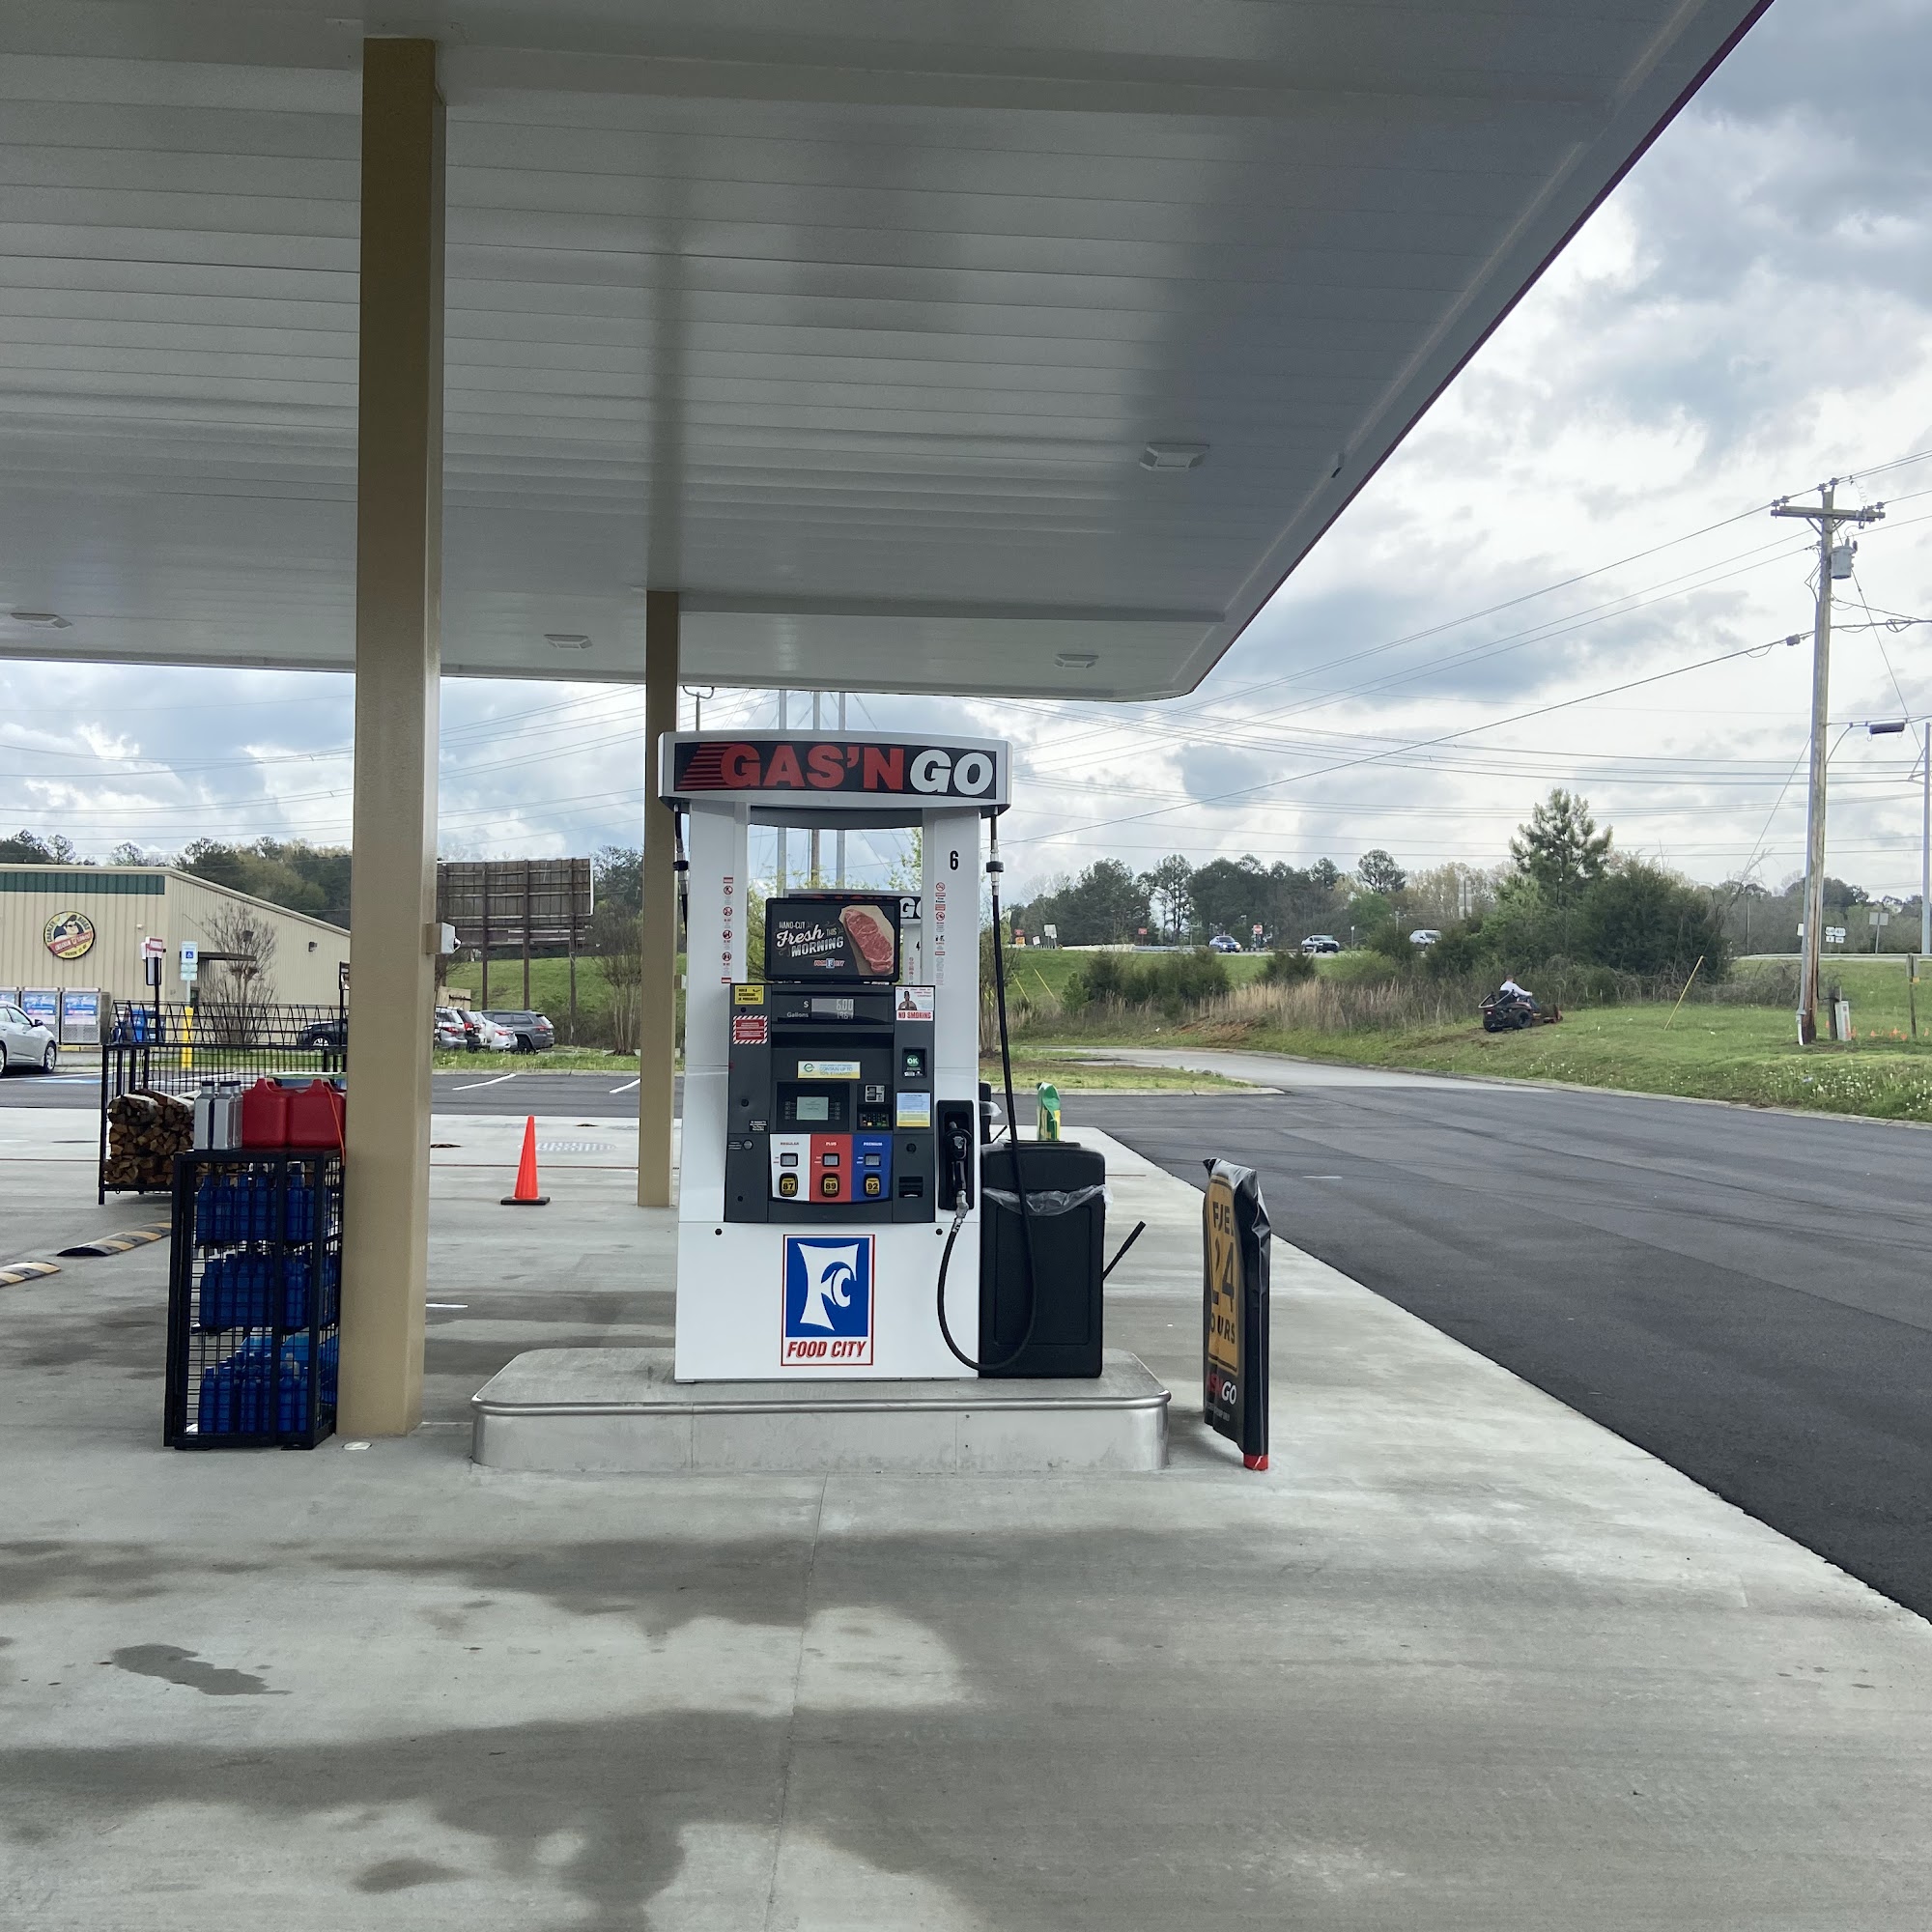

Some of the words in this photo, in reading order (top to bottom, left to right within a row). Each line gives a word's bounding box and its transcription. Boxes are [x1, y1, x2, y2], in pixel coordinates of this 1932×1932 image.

[910, 749, 993, 795] GO
[950, 850, 959, 870] 6
[776, 923, 825, 947] Fresh
[779, 921, 806, 929] HAND-CUT
[791, 936, 844, 957] MORNING
[804, 1000, 810, 1009] $
[1209, 1315, 1236, 1344] OURS
[786, 1341, 828, 1358] FOOD
[831, 1341, 867, 1358] CITY
[1221, 1380, 1236, 1406] GO
